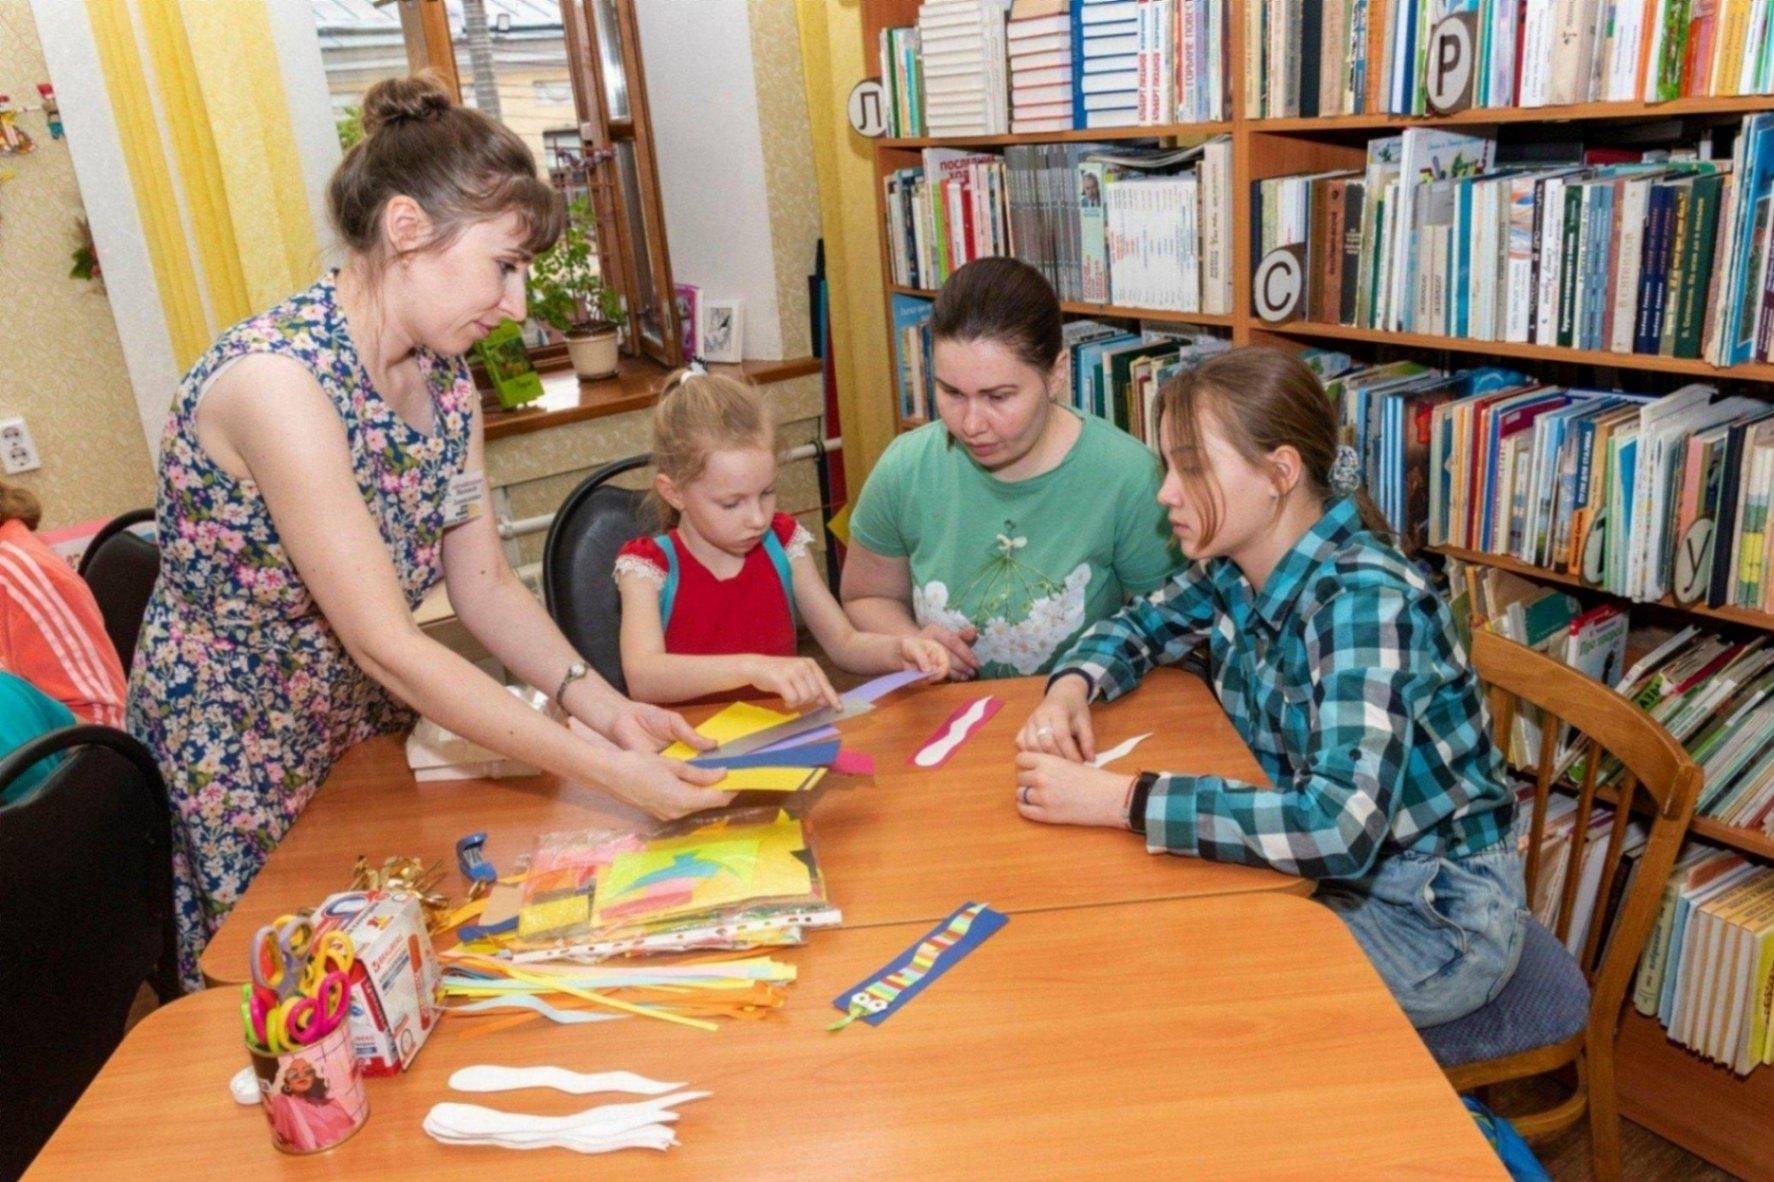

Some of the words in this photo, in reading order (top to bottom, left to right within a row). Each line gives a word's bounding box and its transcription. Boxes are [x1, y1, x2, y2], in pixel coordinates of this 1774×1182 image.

[1138, 53, 1147, 88] ЛИХАНОВ
[1152, 52, 1160, 87] ЛИХАНОВ
[1434, 28, 1462, 98] Р
[859, 90, 883, 130] Л
[1138, 90, 1147, 121] АЛЬБЕРТ
[1152, 89, 1160, 121] АЛЬБЕРТ
[1261, 259, 1294, 311] С
[1581, 430, 1593, 465] СТАЛИНА
[1580, 466, 1590, 482] ДЛЯ
[1683, 527, 1713, 595] У
